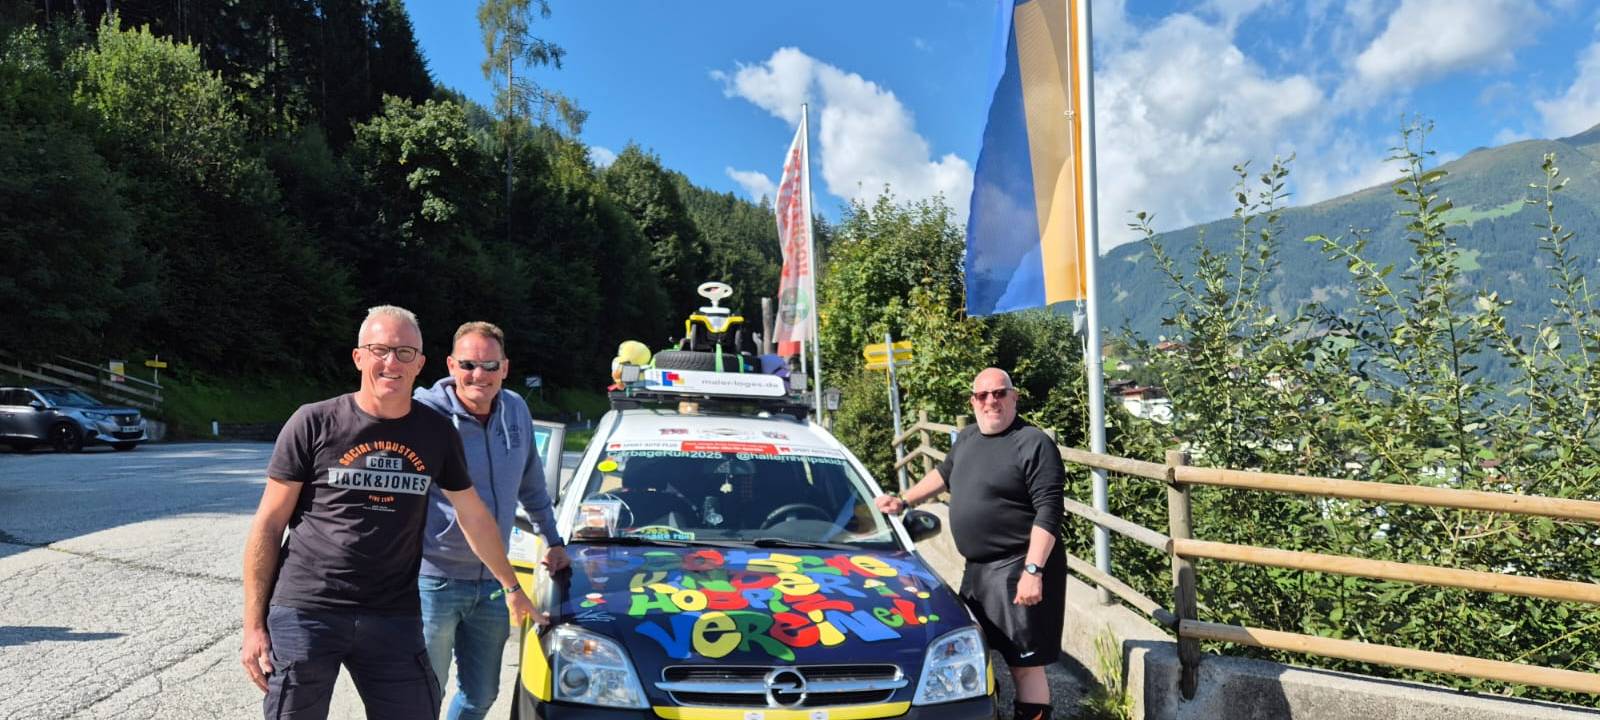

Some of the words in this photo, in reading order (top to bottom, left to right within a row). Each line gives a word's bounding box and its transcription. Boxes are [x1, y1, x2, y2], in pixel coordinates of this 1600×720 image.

[339, 442, 372, 466] SOCIAL
[374, 440, 426, 472] INDUSTRIES
[370, 458, 399, 469] CORE
[334, 472, 428, 492] JACK&JONES
